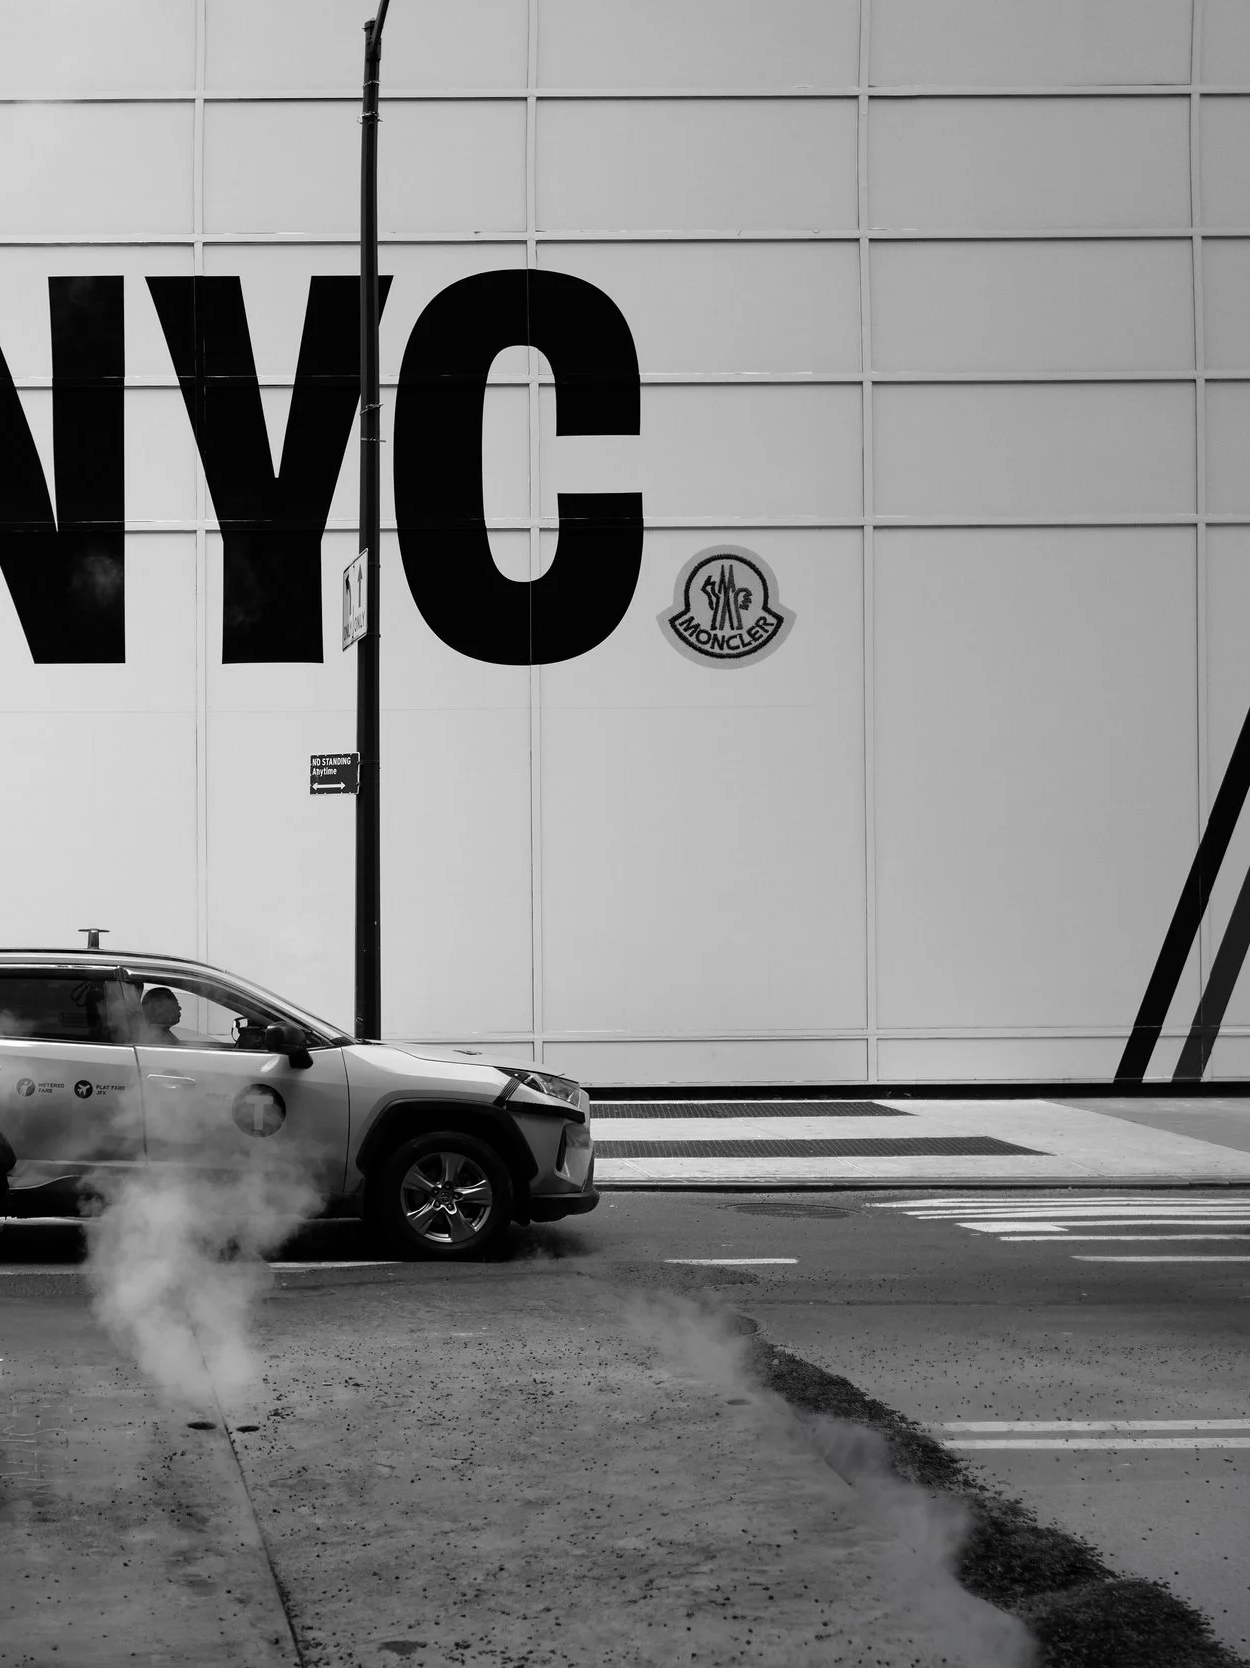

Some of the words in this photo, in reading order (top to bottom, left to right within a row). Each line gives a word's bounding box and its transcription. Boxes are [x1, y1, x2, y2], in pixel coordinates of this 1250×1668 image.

[678, 616, 775, 651] MONCLER
[312, 758, 321, 766] NO
[321, 757, 352, 766] STANDING
[312, 767, 338, 777] Anytime
[244, 1095, 274, 1130] T
